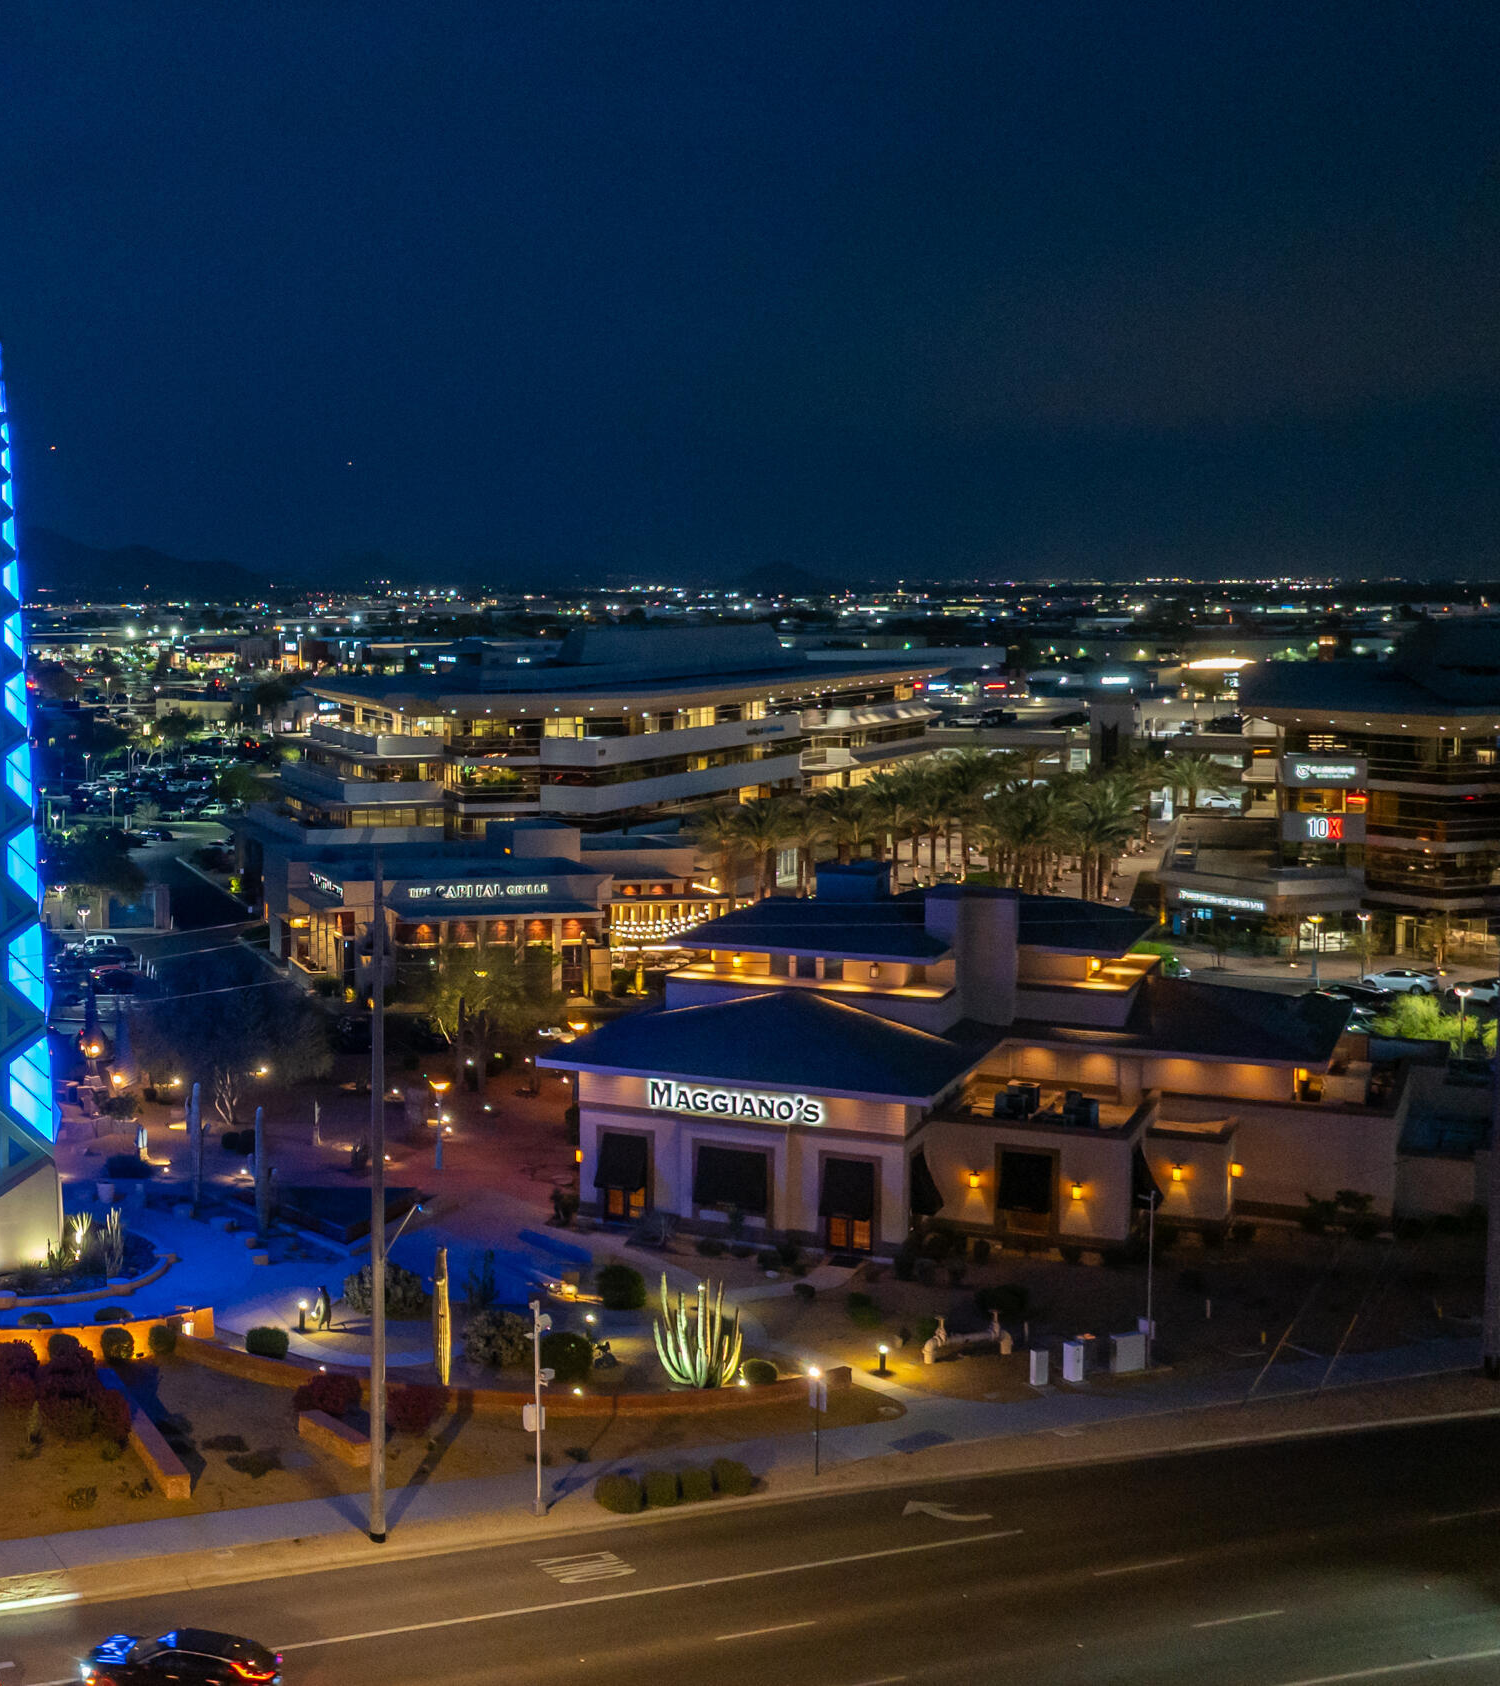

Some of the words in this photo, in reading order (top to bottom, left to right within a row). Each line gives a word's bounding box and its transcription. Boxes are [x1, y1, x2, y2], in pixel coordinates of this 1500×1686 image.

[1307, 817, 1342, 839] 10X
[435, 884, 505, 899] CAPITAL
[506, 884, 549, 895] GRILLE
[648, 1079, 822, 1124] MAGGIANO'S
[531, 1551, 636, 1583] ONLY
